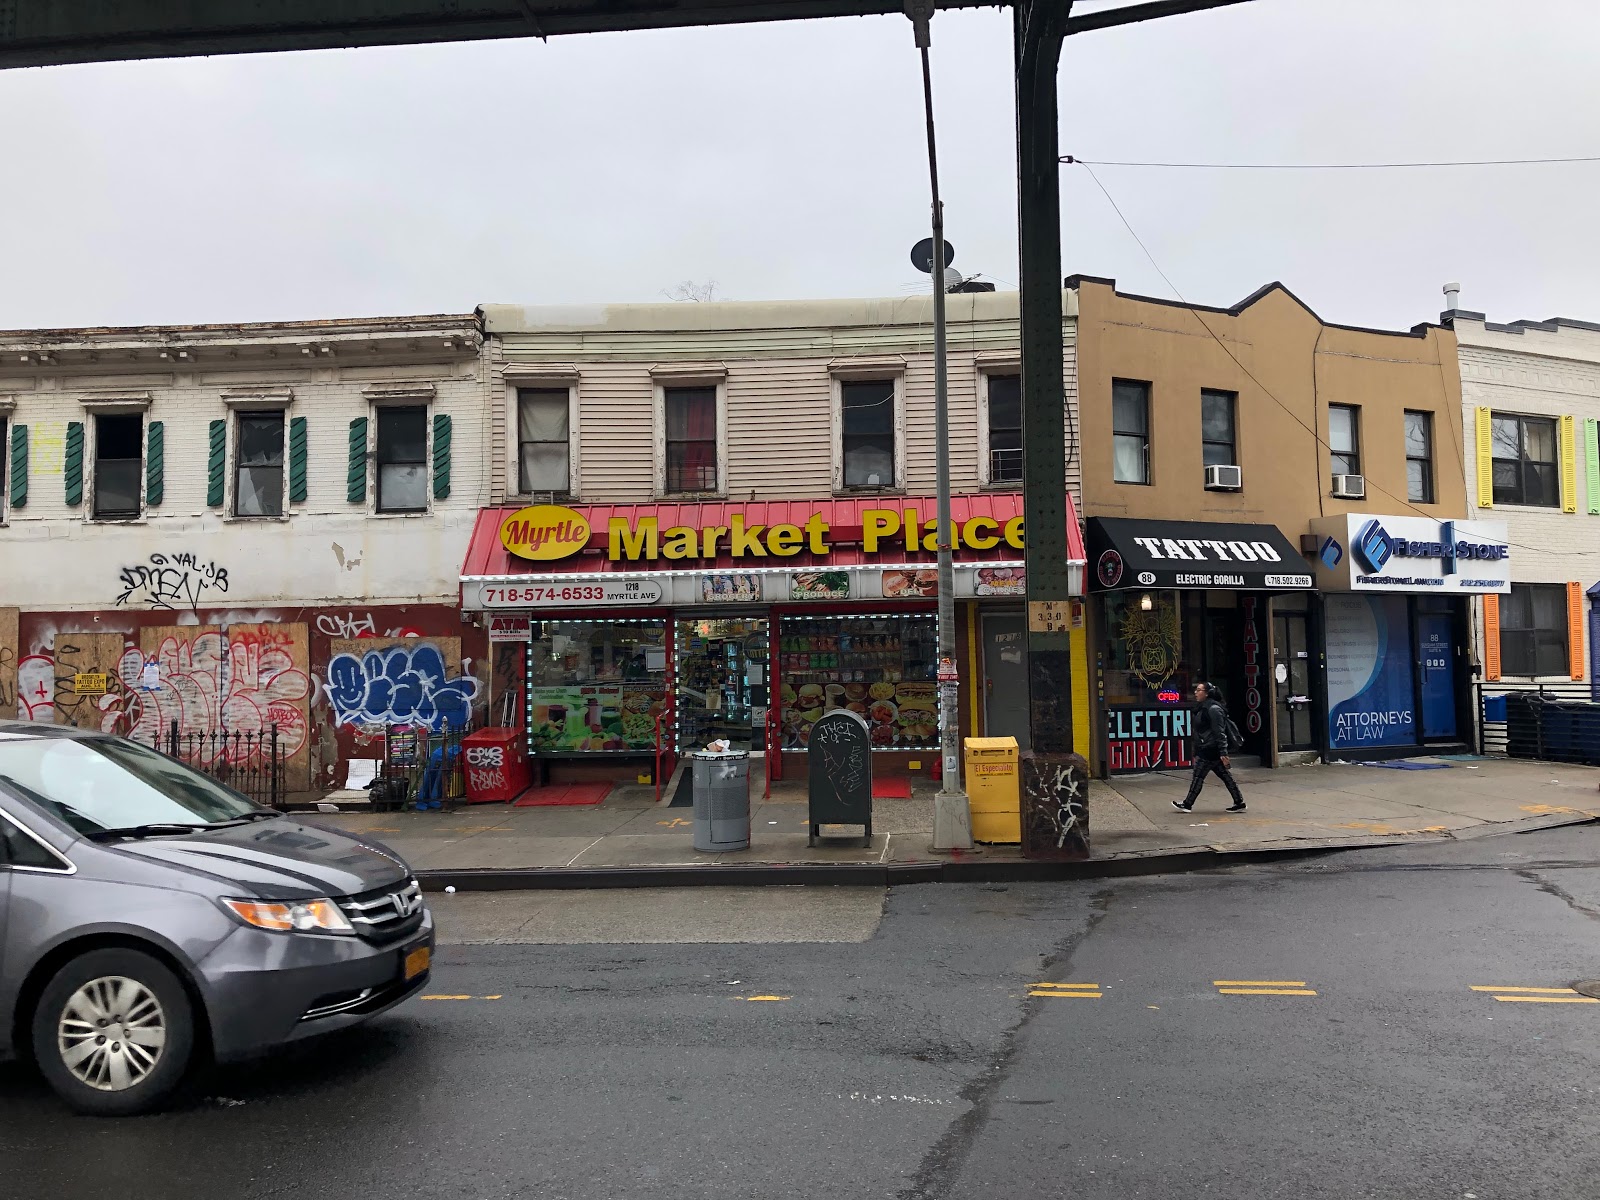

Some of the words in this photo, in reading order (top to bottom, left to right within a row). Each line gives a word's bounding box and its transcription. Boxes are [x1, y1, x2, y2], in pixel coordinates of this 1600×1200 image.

[506, 520, 586, 552] Myrtle
[608, 511, 830, 561] Market
[863, 508, 1024, 553] Place
[1134, 537, 1281, 562] TATTOO
[1141, 574, 1152, 584] 88
[1176, 574, 1212, 584] ELECTRIC
[1213, 574, 1244, 585] GORILLA
[625, 582, 639, 591] 1218
[486, 586, 604, 603] 718-574-6533
[607, 592, 639, 601] MYRTLE
[640, 592, 656, 600] AVE
[707, 593, 754, 601] GROCERY
[797, 591, 844, 599] PRODUCE
[491, 618, 529, 630] ATM
[1243, 596, 1261, 733] TATTOO
[1109, 710, 1192, 738] ELECTRI
[1336, 711, 1412, 726] ATTORNEYS
[1338, 727, 1354, 740] AT
[1357, 726, 1383, 739] LAW
[1110, 740, 1192, 768] GORILL
